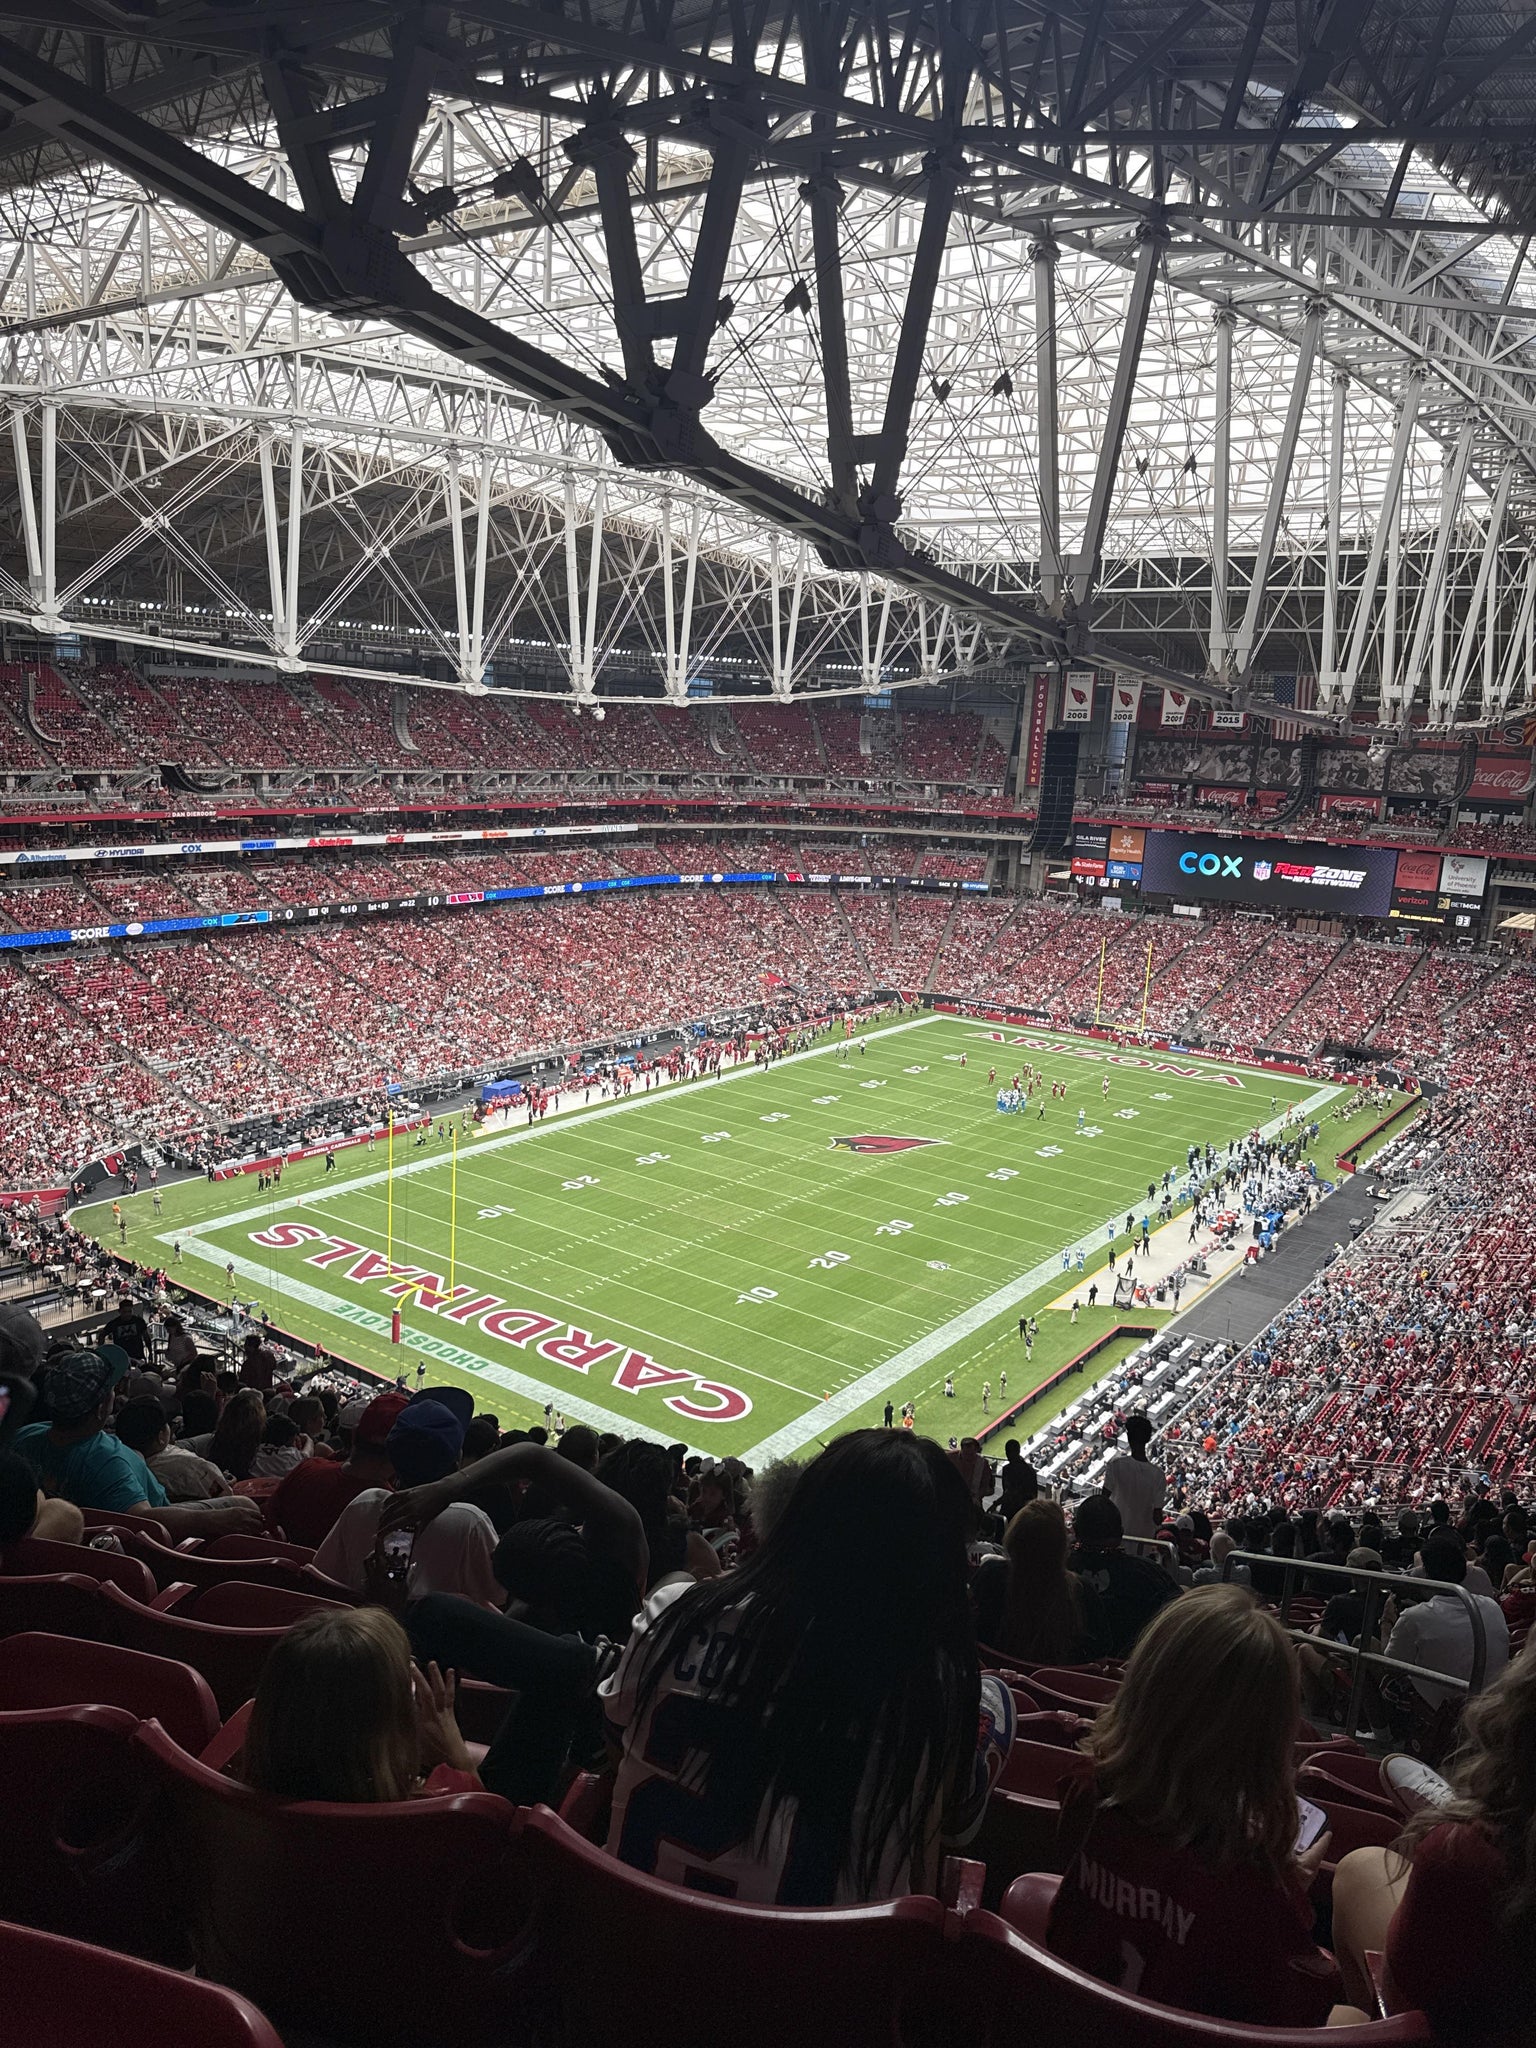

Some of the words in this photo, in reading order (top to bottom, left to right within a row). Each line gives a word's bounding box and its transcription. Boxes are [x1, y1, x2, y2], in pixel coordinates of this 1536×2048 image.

[1034, 685, 1045, 749] FOOTBALL
[1216, 716, 1240, 724] 2015
[1030, 752, 1038, 783] CLUB
[109, 848, 145, 856] HYUNDAI
[181, 844, 202, 853] COX
[30, 853, 67, 861] Albertsons
[1179, 851, 1243, 878] COX
[680, 875, 704, 883] SCORE
[1255, 869, 1271, 879] NFL
[1448, 874, 1476, 883] University
[1292, 876, 1311, 884] NFL
[1311, 877, 1362, 889] NETWORK
[544, 885, 565, 894] SCORE
[428, 896, 439, 906] 10
[1398, 896, 1429, 905] verizon
[1451, 902, 1481, 910] BETMGM
[285, 909, 294, 919] 0
[340, 905, 358, 914] 4:10
[202, 918, 218, 926] COX
[71, 927, 110, 941] SCORE
[1026, 1020, 1052, 1029] ARIZONA
[1055, 1025, 1090, 1036] CARDNALS
[963, 1031, 1247, 1089] ARIZONA
[902, 1065, 930, 1075] 20
[859, 1079, 888, 1089] 30
[811, 1094, 840, 1105] 40
[759, 1112, 791, 1123] 50
[1112, 1108, 1141, 1120] 20
[701, 1130, 732, 1143] 40
[1074, 1126, 1104, 1138] 30
[303, 1145, 330, 1158] ARIZONA
[330, 1137, 361, 1151] CARDINALS
[1034, 1145, 1064, 1158] 40
[635, 1151, 671, 1165] 30
[985, 1167, 1020, 1181] 50
[562, 1174, 600, 1190] 20
[936, 1191, 970, 1207] 40
[477, 1204, 516, 1219] 10
[876, 1219, 914, 1236] 30
[809, 1250, 851, 1269] 20
[738, 1286, 778, 1304] 10
[248, 1222, 753, 1423] CARDINALS
[332, 1303, 393, 1332] LOVE
[400, 1329, 489, 1372] CHOOSE
[1080, 1852, 1196, 1946] MURRAY
